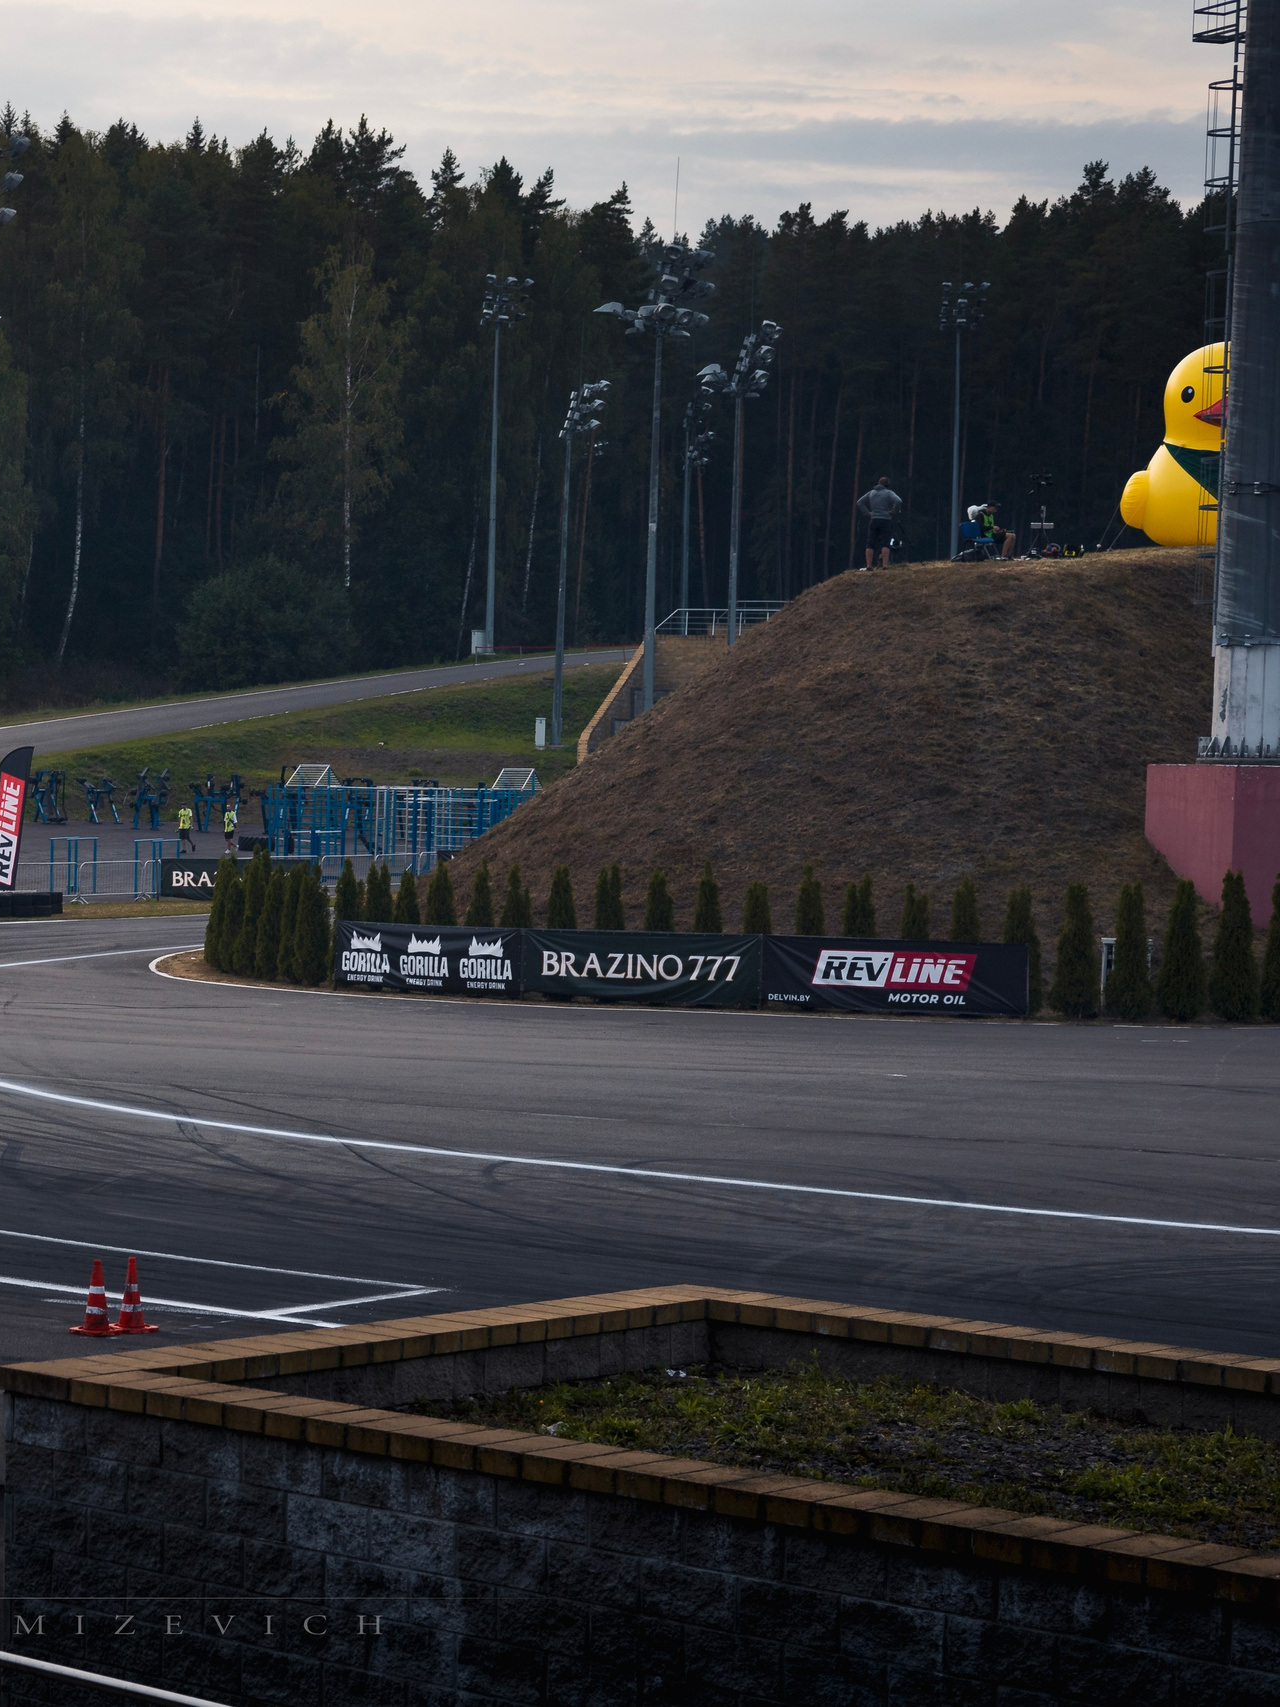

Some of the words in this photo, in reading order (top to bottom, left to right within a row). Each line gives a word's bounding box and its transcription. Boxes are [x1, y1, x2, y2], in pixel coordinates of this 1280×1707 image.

[172, 870, 218, 887] BRA
[341, 951, 391, 974] GORILLA
[399, 955, 449, 978] GORILLA
[459, 958, 513, 981] GORILLA
[347, 973, 367, 982] ENERGY
[367, 975, 384, 983] DRINK
[405, 977, 426, 987] ENERGY
[427, 979, 443, 987] DRINK
[466, 981, 488, 990] ENERGY
[488, 982, 506, 990] DRINK
[768, 993, 811, 1002] DELVIN.BY
[887, 992, 938, 1005] MOTOR
[943, 994, 967, 1006] OIL
